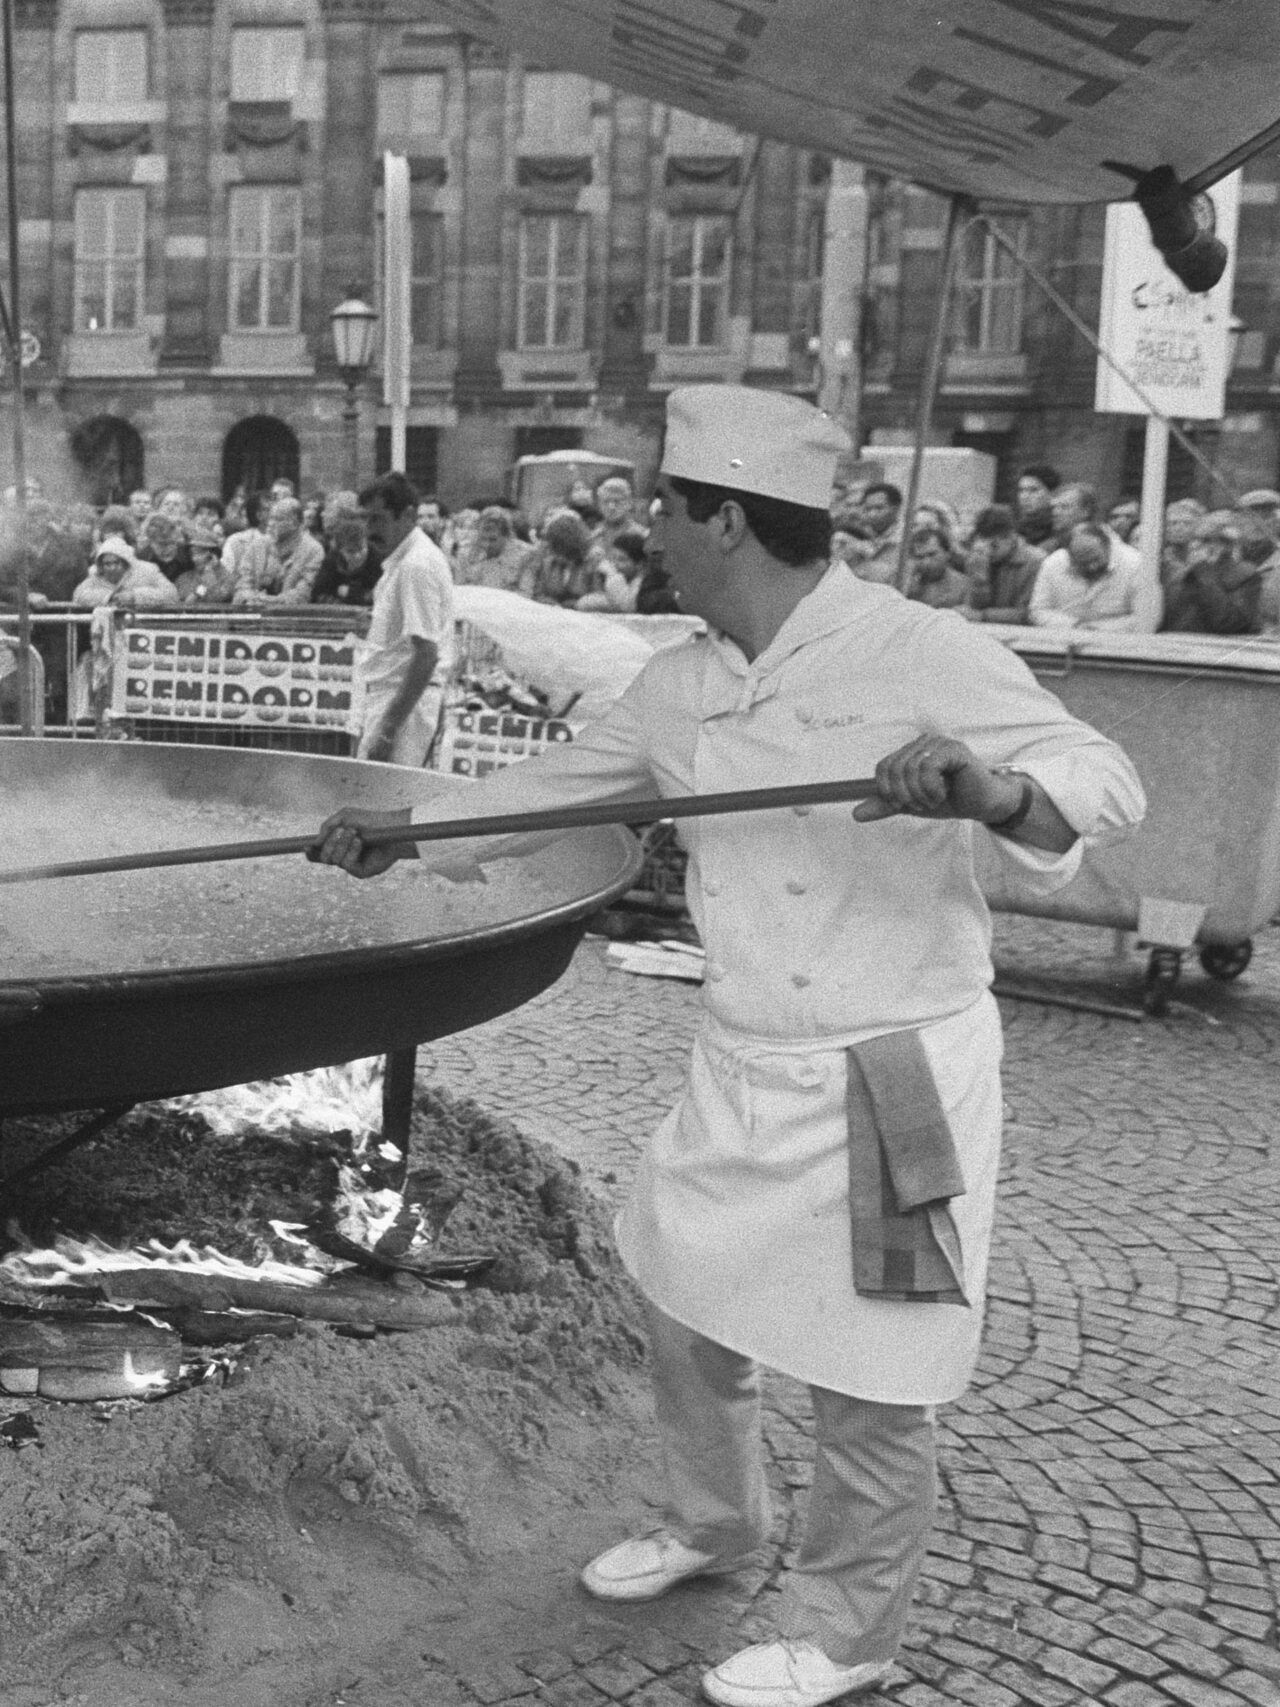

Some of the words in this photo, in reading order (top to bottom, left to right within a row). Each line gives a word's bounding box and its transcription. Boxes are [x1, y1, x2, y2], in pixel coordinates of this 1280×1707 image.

[126, 633, 354, 682] BENIDORM
[125, 677, 352, 726] BENIDORM
[452, 703, 574, 757] BENID
